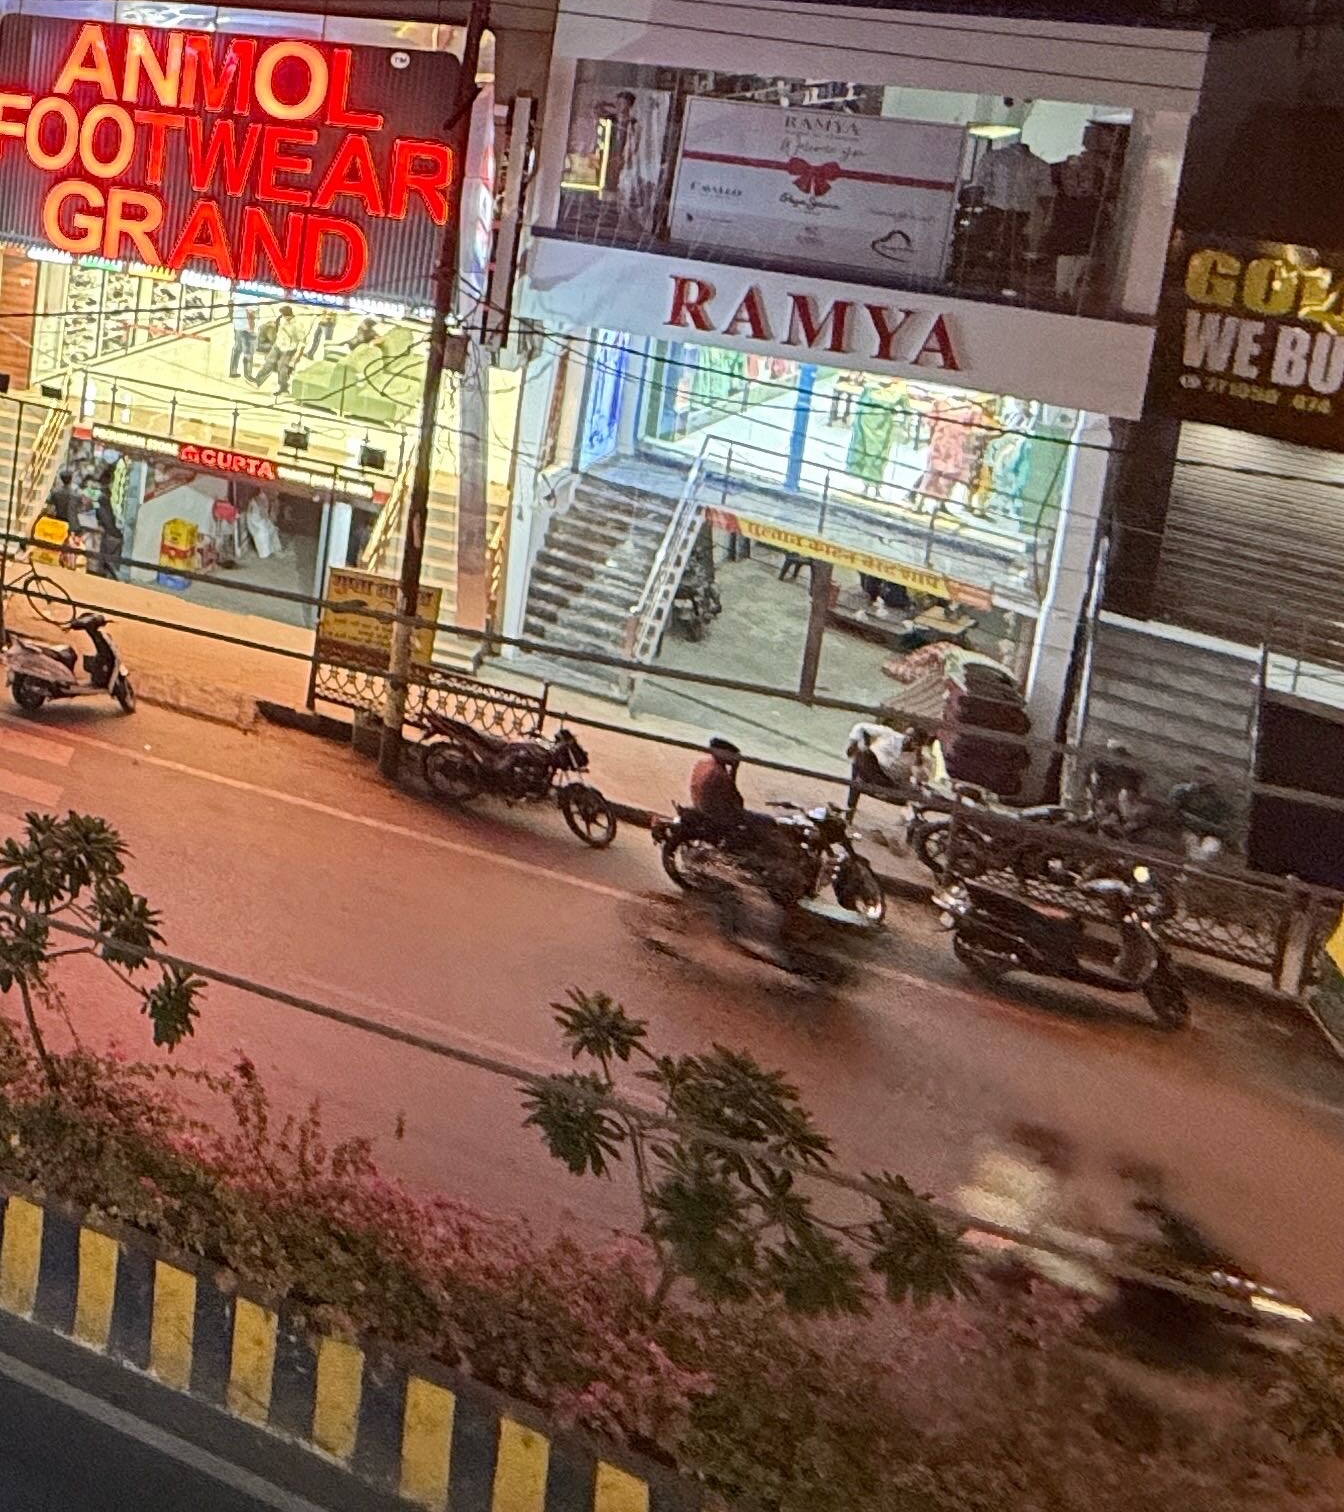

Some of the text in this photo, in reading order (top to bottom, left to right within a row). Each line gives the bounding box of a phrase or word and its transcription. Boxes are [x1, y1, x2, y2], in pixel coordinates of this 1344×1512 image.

[53, 22, 385, 132] ANMOL
[784, 114, 861, 137] RAMYA
[42, 178, 369, 293] GRAND
[662, 274, 963, 371] RAMYA
[1183, 308, 1265, 379] WE
[199, 449, 276, 481] GUPTA
